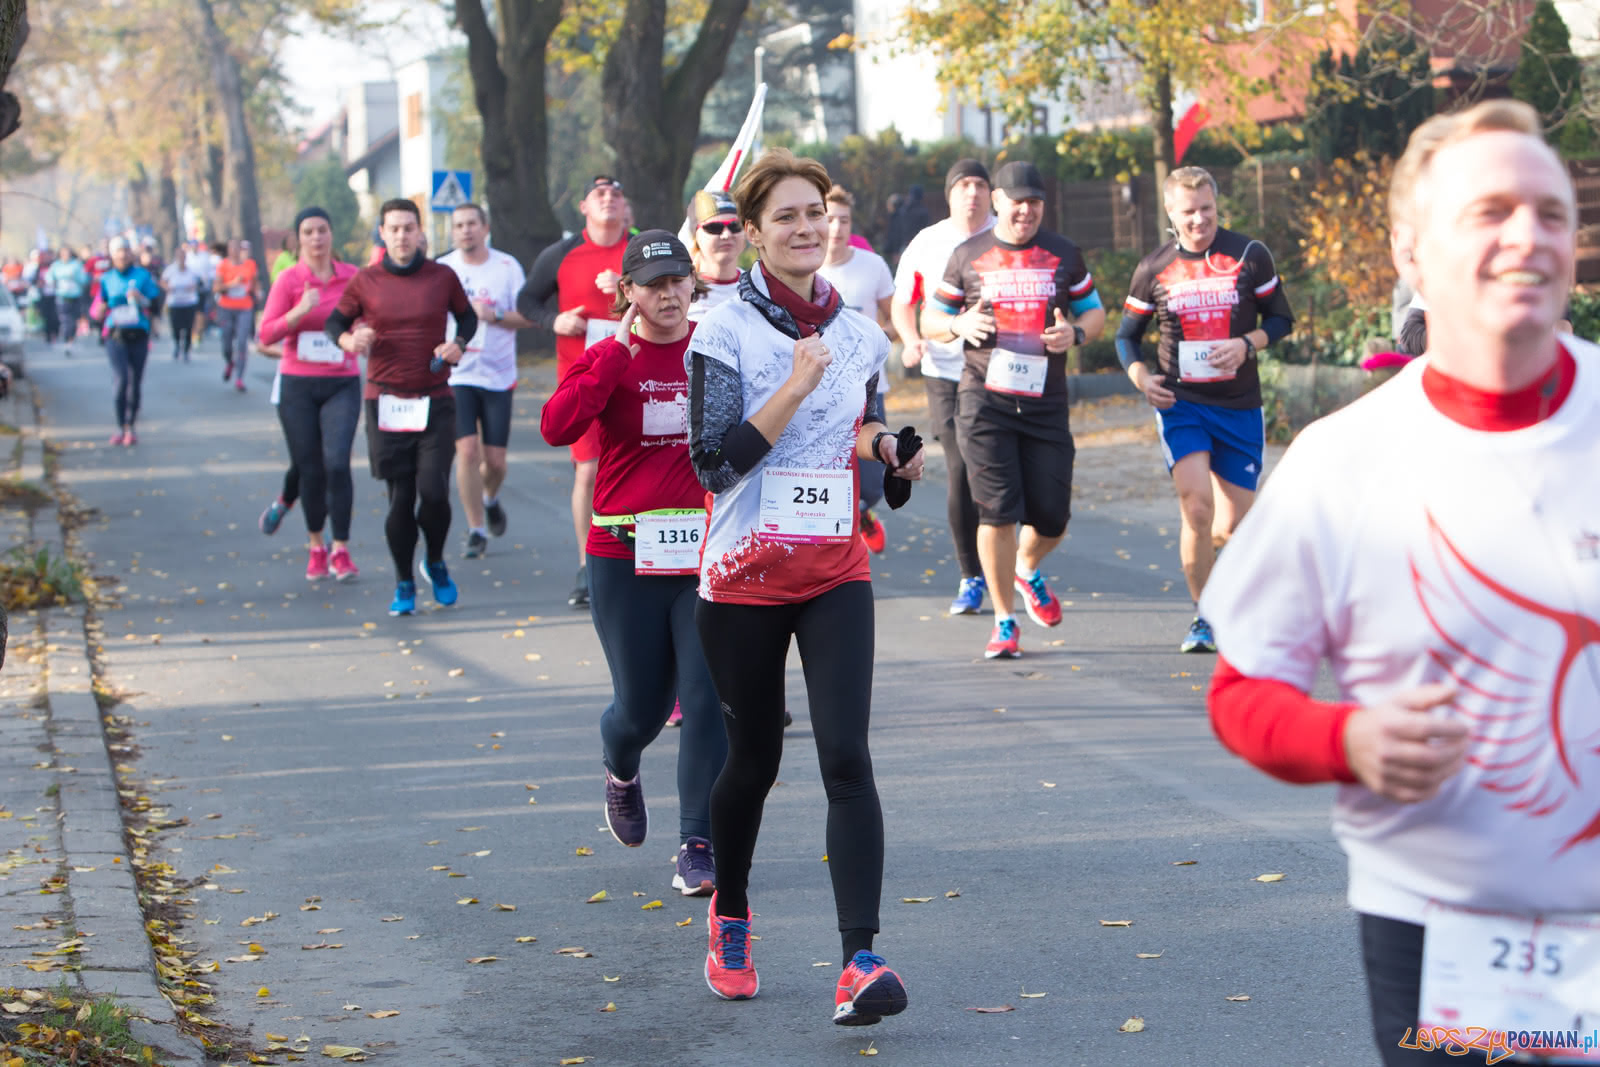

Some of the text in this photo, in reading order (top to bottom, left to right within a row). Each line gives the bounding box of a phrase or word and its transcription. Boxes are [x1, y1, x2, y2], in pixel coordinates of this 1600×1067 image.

[1008, 362, 1029, 374] 995
[793, 486, 829, 504] 254
[795, 510, 826, 518] Agnieszka
[658, 528, 699, 544] 1316
[1491, 936, 1562, 976] 235
